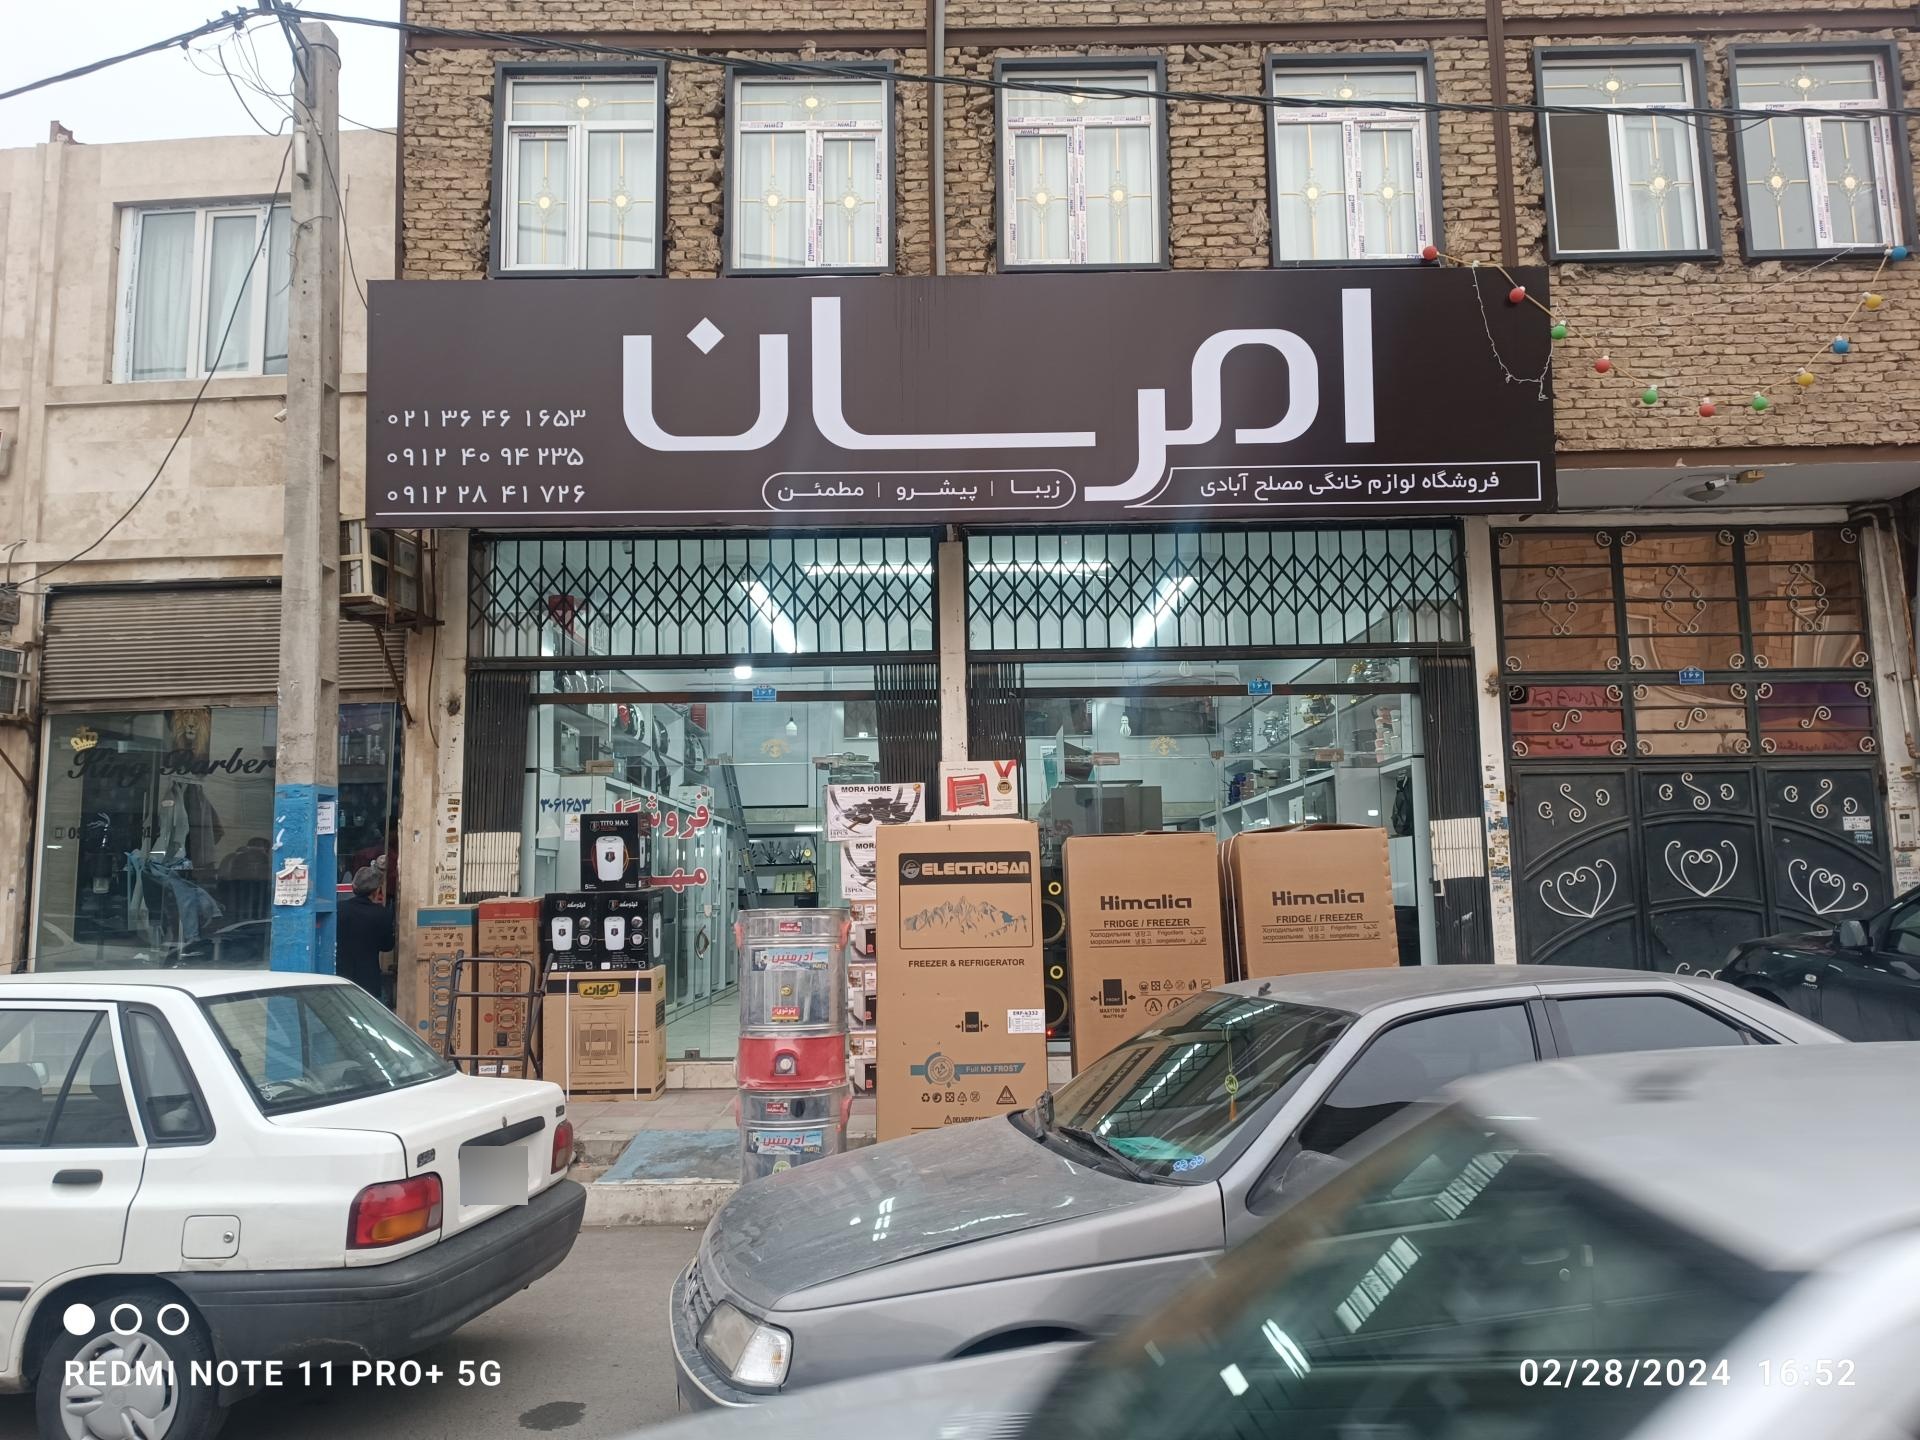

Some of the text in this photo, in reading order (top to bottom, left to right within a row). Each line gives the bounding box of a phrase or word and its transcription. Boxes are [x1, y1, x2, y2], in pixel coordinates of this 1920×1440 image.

[387, 409, 586, 428] ۰۲۱ ۳۶ ۴۶ ۱۶۵۳
[387, 447, 584, 466] ۰۹۱۲ ۴۰ ۹۴ ۲۳۵
[387, 484, 585, 504] ۰۹۱۲ ۲۸ ۴۱ ۷۲۶
[1200, 471, 1500, 501] فروشگاه لوازم خانگی مصلح آبادی
[855, 842, 876, 850] MOR
[921, 861, 1030, 877] ELECTROSAN
[1100, 894, 1193, 910] Himalia
[1271, 889, 1365, 906] Himalia
[1103, 920, 1139, 928] FRIDGE
[1146, 919, 1191, 927] FREEZER
[1276, 914, 1312, 923] FRIDGE
[1319, 913, 1364, 922] FREEZER
[908, 960, 945, 968] FREEZER
[958, 958, 1025, 967] REFRIGERATOR
[583, 983, 615, 996] توان
